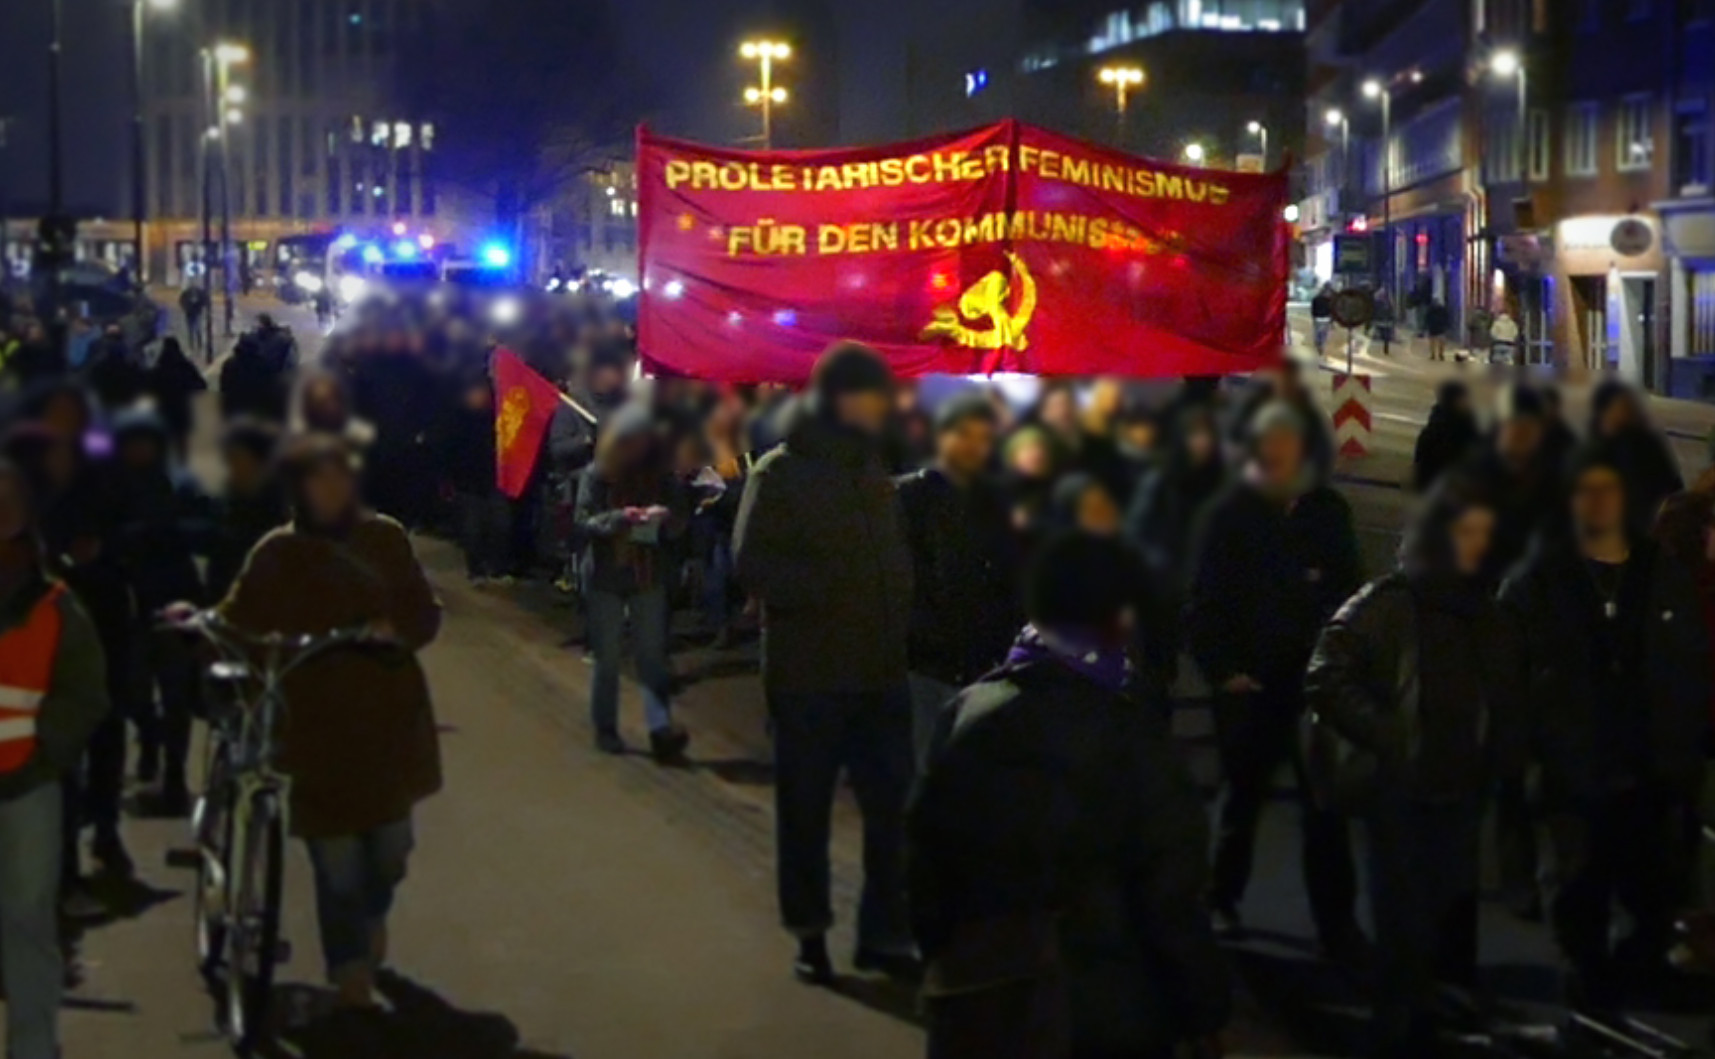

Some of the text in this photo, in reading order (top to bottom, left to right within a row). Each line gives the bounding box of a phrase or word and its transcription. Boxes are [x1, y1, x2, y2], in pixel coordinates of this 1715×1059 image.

[728, 210, 1186, 257] FÜR DEN KOMMUNIS
